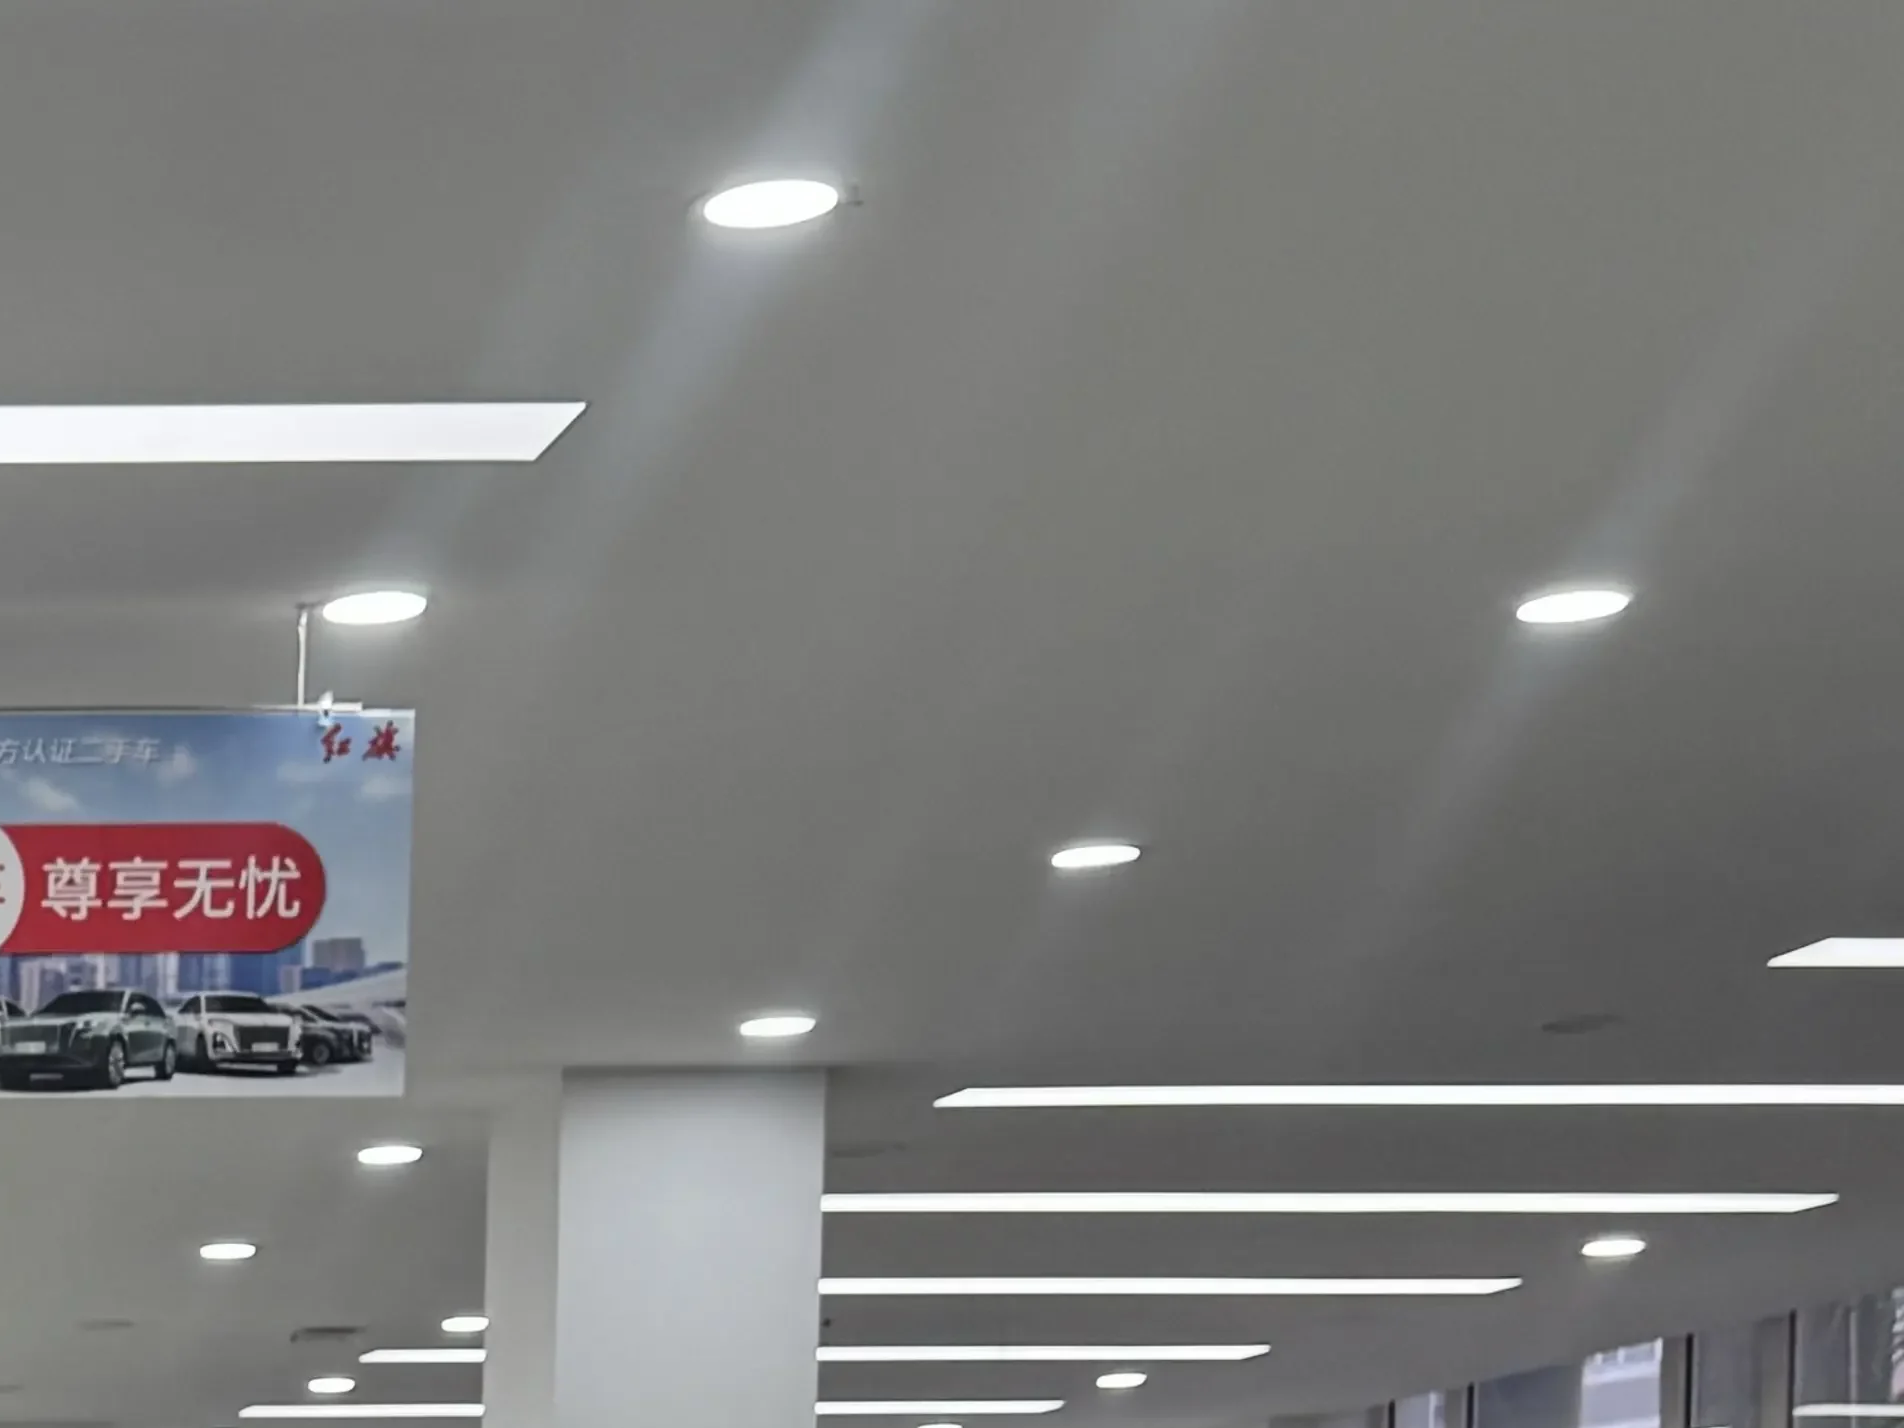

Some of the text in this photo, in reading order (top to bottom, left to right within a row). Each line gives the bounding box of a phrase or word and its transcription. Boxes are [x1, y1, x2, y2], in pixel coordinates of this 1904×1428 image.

[320, 720, 401, 764] 红旗
[41, 857, 301, 920] 尊享无忧
